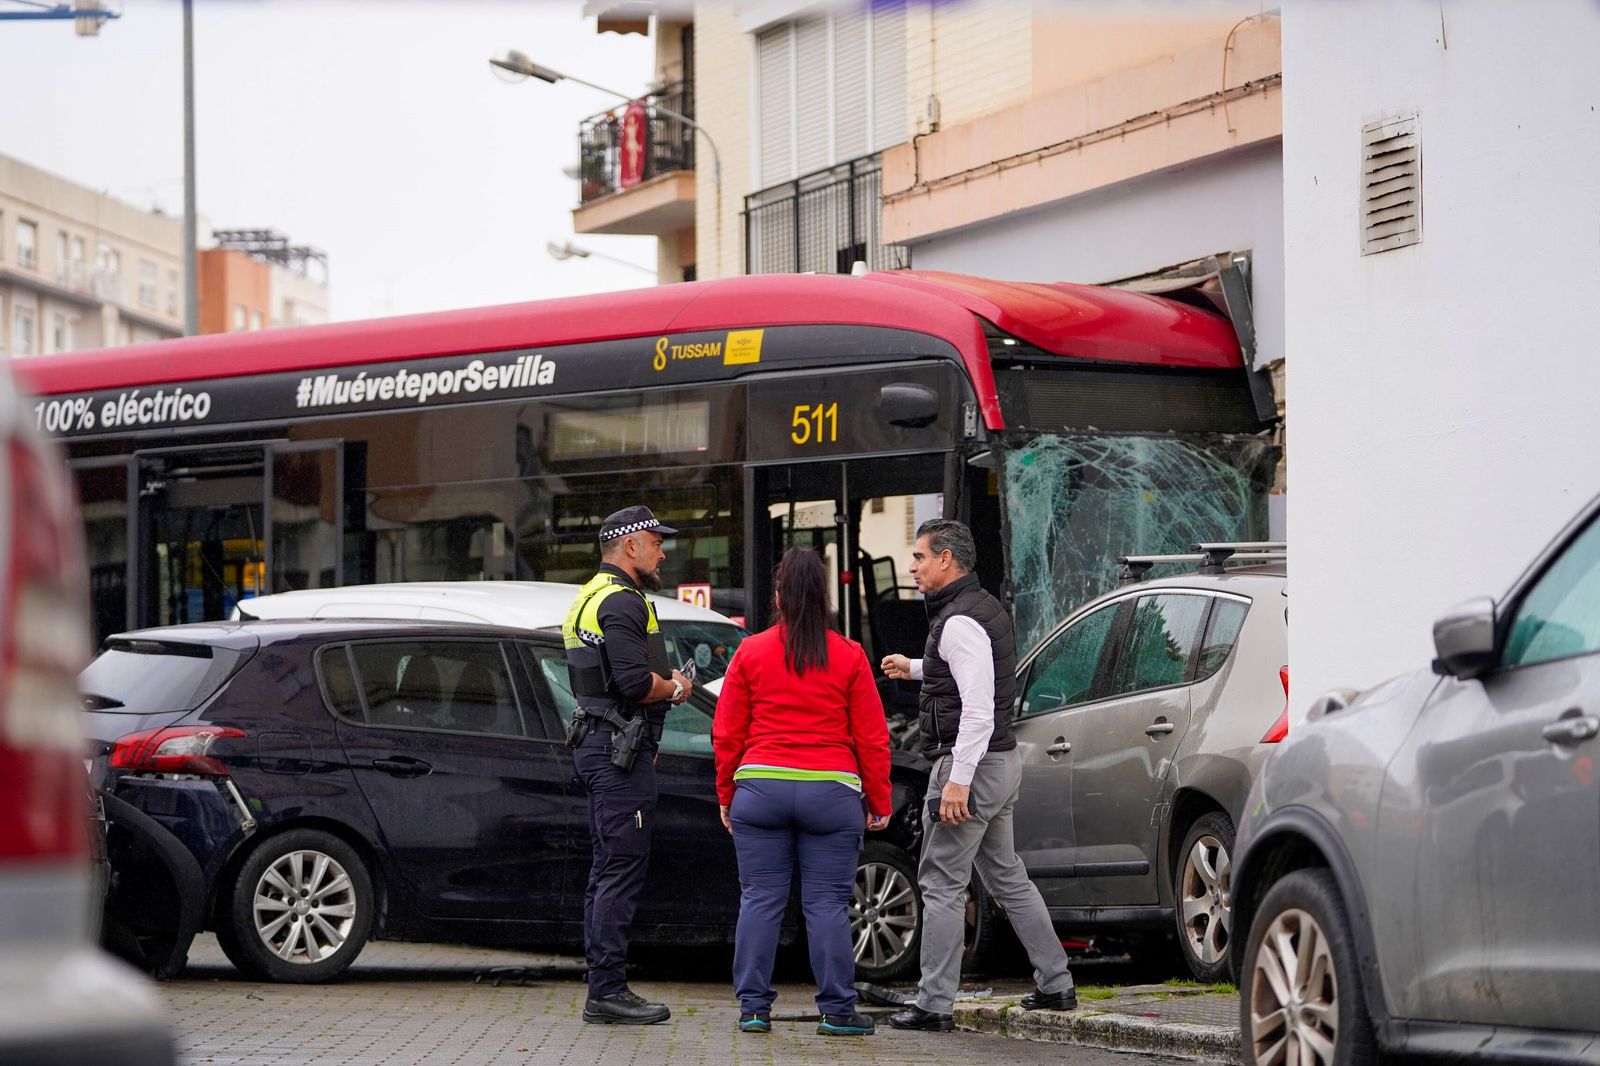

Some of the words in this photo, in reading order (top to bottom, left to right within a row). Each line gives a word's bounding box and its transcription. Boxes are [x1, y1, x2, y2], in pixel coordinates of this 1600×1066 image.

[671, 342, 721, 360] TUSSAM
[296, 355, 557, 408] #MuéveteporSevilla
[34, 397, 95, 432] 100%
[101, 387, 211, 427] eléctrico
[791, 402, 838, 445] 511
